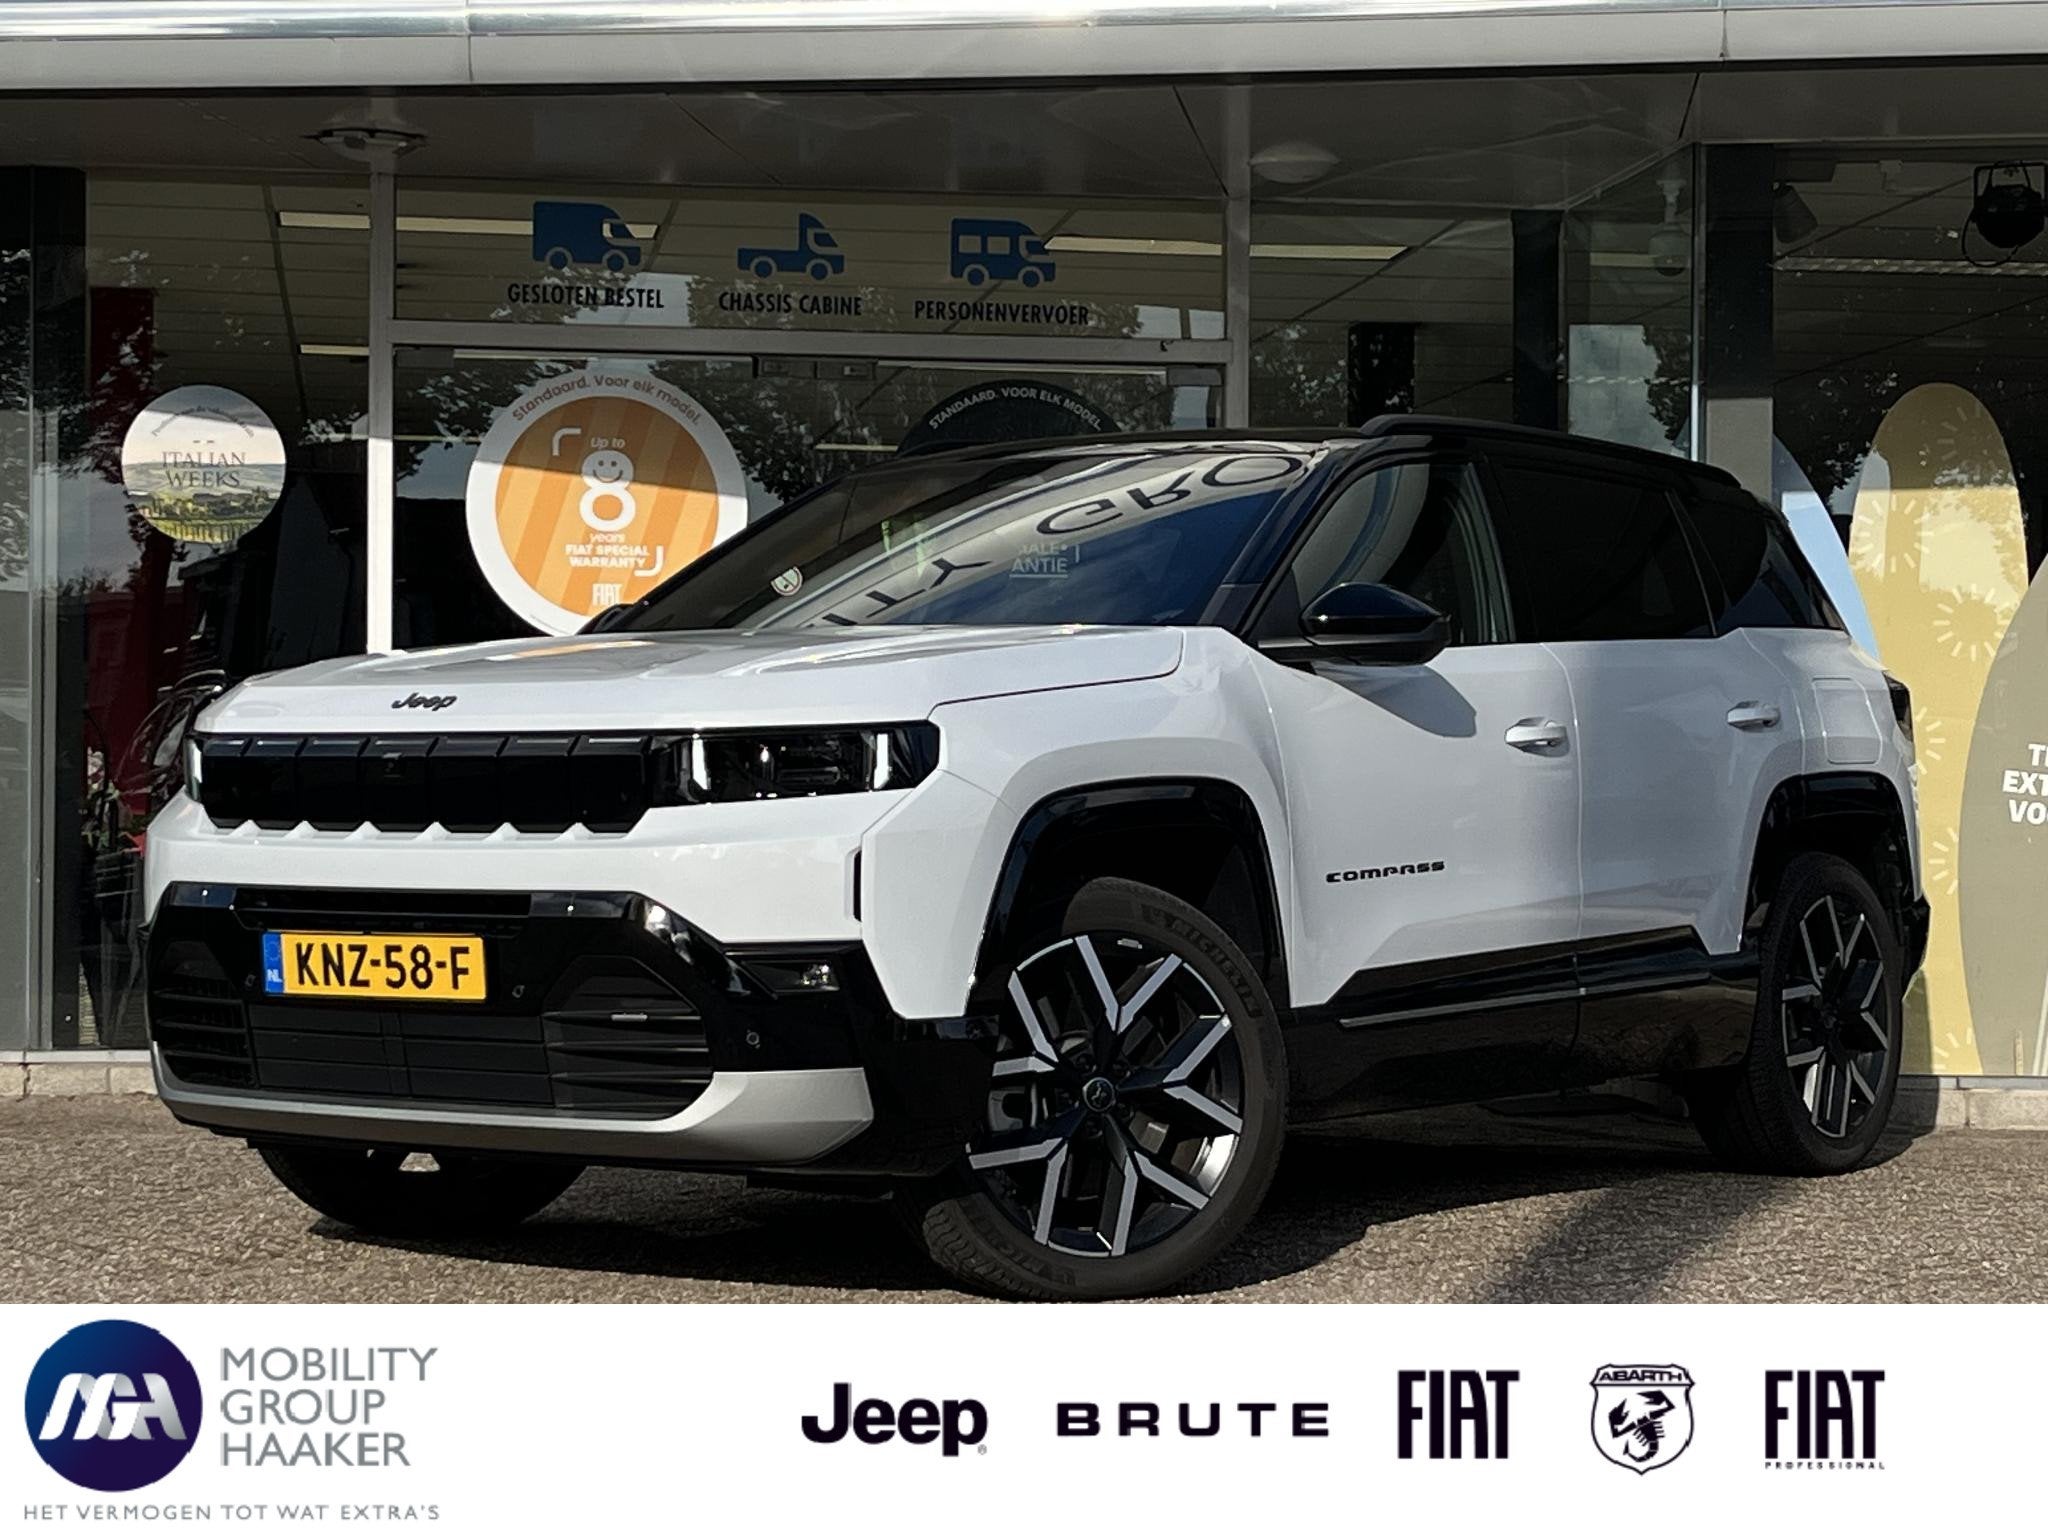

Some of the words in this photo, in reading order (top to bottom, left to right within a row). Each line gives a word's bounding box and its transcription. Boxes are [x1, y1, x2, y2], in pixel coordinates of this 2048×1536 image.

[507, 283, 597, 305] GESLOTEN
[605, 287, 664, 309] BESTEL
[718, 291, 792, 313] CHASSIS
[800, 295, 862, 316] CABINE
[914, 300, 1089, 325] PERSONENVERVOER
[594, 374, 629, 387] Voor
[632, 380, 655, 394] elk
[1001, 387, 1037, 399] VOOR
[1039, 389, 1062, 405] ELK
[612, 437, 626, 449] to
[162, 451, 246, 468] ITALIAN
[165, 471, 240, 488] WEEKS
[565, 544, 594, 556] FIAT
[596, 545, 650, 557] SPECIAL
[569, 556, 646, 568] WARRANTY
[592, 583, 623, 606] FIAT
[391, 692, 457, 711] Jeep
[2028, 744, 2048, 767] T
[2008, 799, 2048, 825] VO
[1326, 861, 1445, 883] COMPASS
[267, 969, 282, 982] NL
[296, 942, 470, 990] KNZ-58-F
